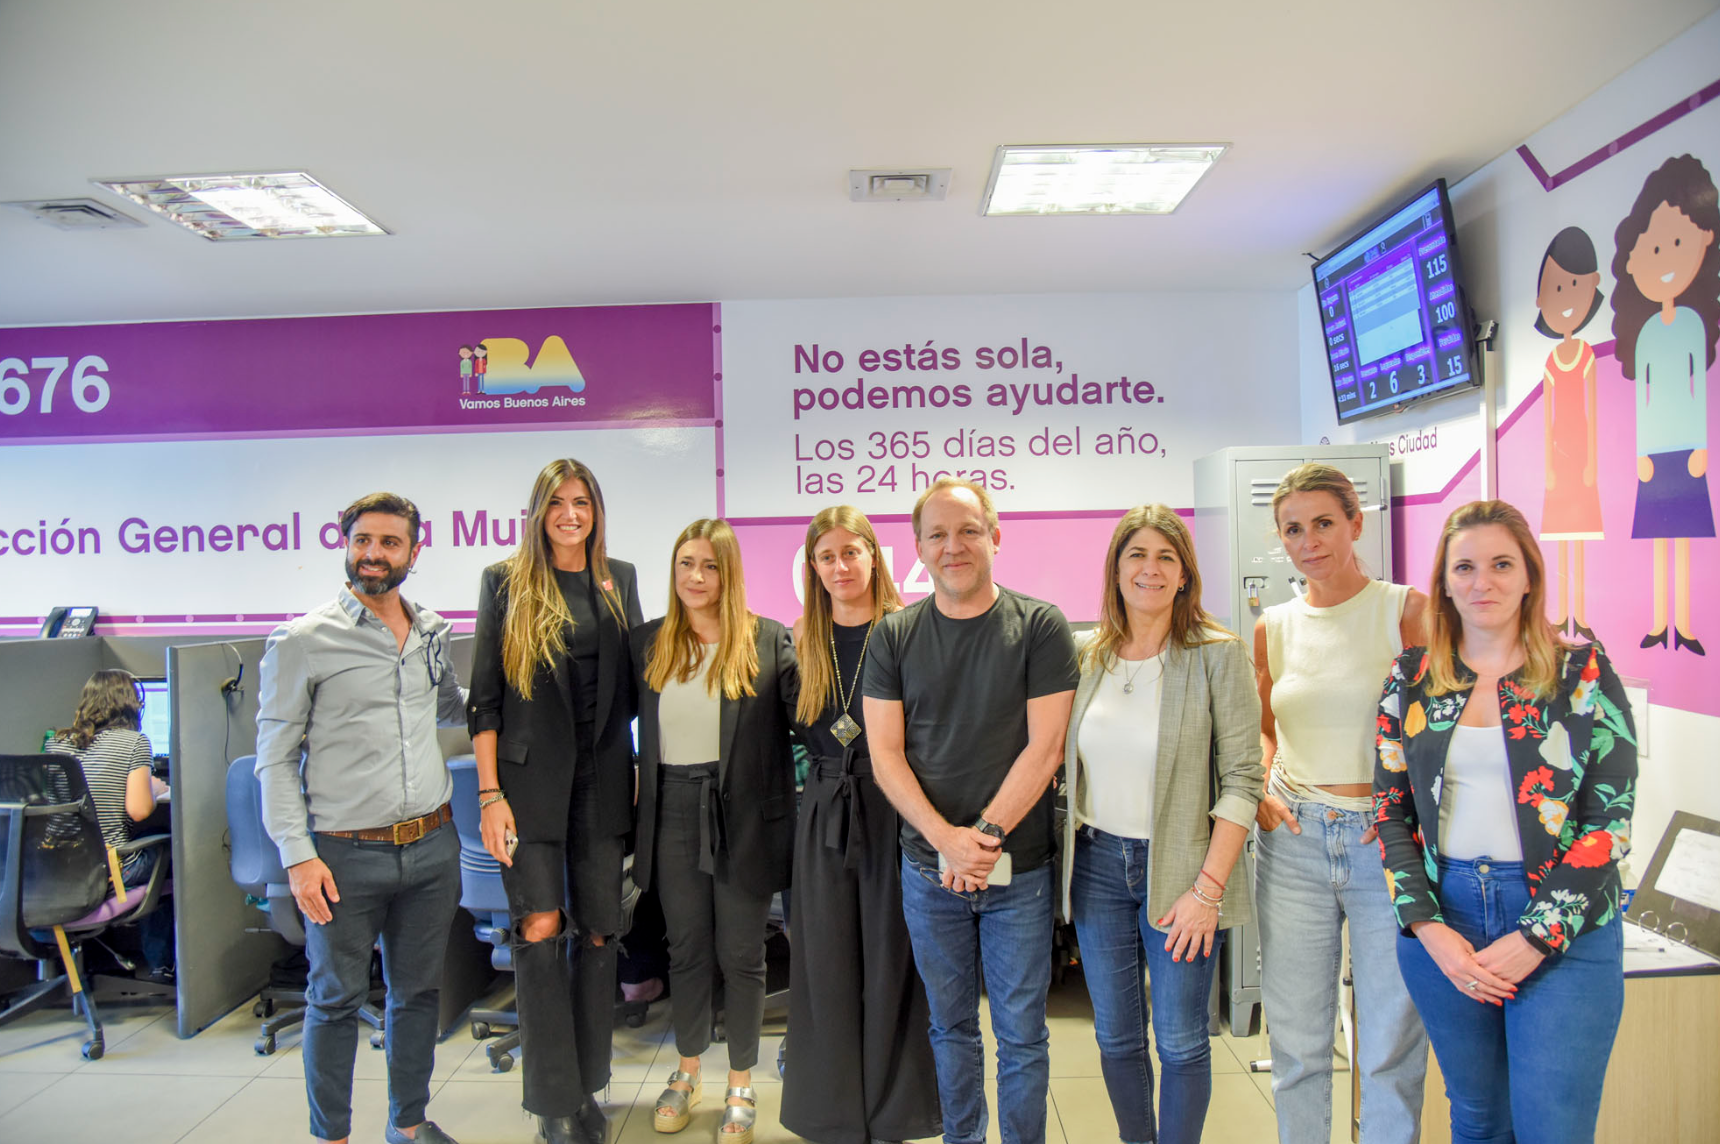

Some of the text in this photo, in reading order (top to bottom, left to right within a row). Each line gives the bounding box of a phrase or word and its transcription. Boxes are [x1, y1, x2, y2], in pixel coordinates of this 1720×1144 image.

[1426, 253, 1447, 279] 115
[1435, 301, 1455, 323] 100
[483, 334, 586, 396] BA
[794, 337, 1063, 374] No estás sola,
[1446, 354, 1463, 377] 15
[0, 355, 111, 416] 676
[1389, 370, 1398, 394] 6
[1417, 364, 1425, 385] 3
[459, 395, 586, 410] Vamos Buenos Aires
[794, 374, 1165, 420] podemos ayudarte.
[1369, 381, 1377, 399] 2
[795, 426, 1167, 461] Los 365 días del año,
[1398, 426, 1437, 454] Ciudad
[796, 465, 844, 494] las
[856, 465, 898, 493] 24
[117, 511, 302, 554] General
